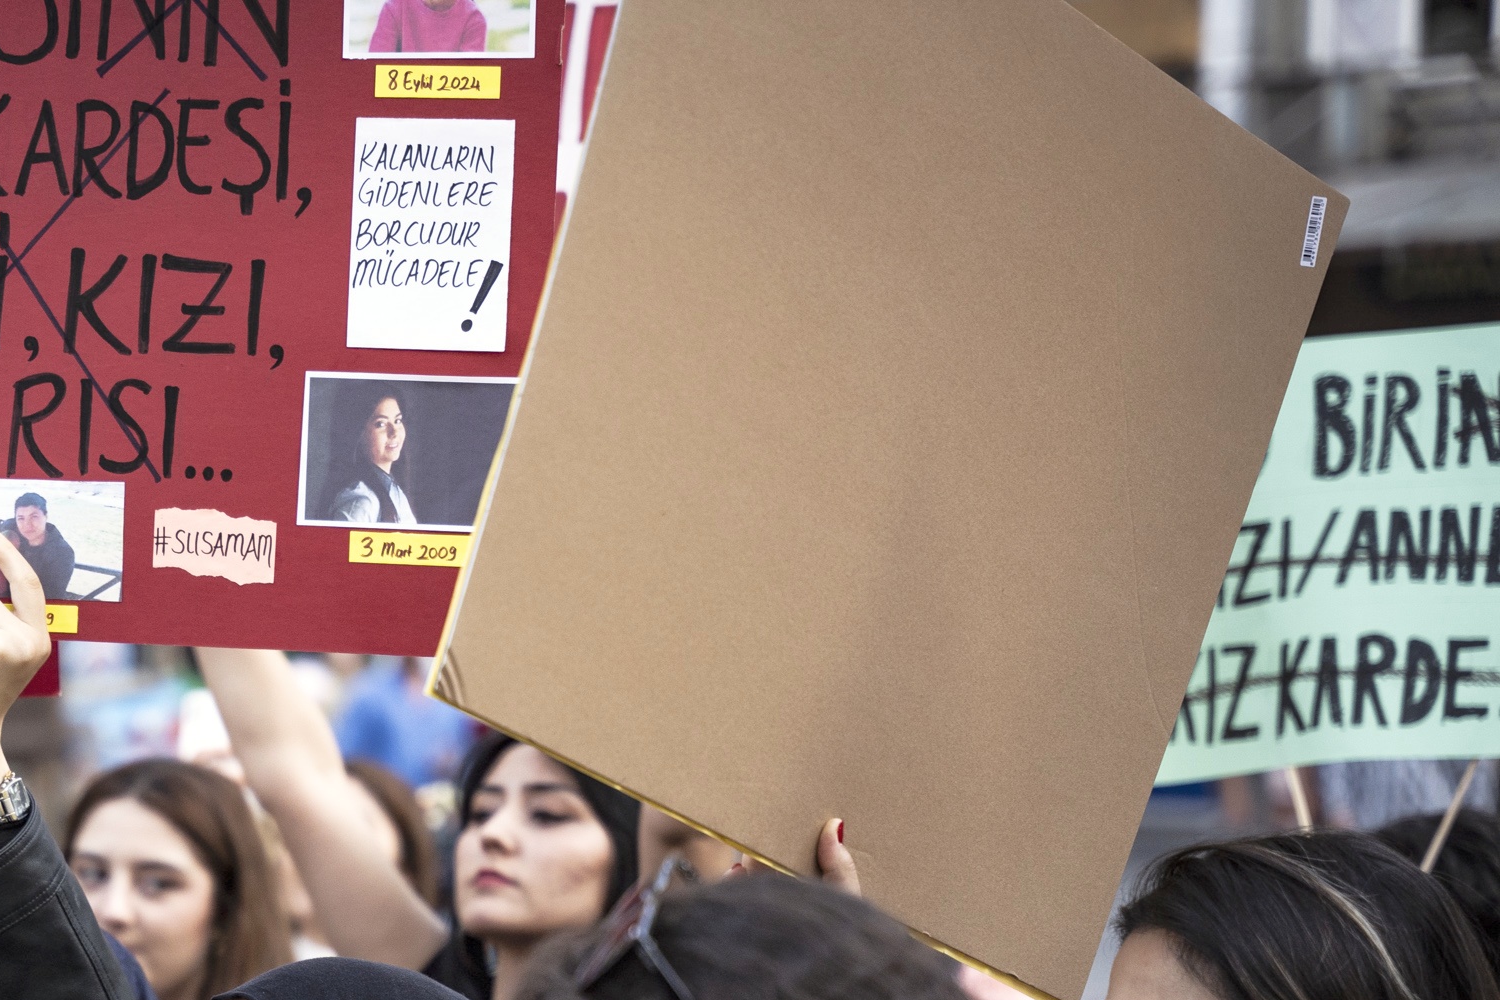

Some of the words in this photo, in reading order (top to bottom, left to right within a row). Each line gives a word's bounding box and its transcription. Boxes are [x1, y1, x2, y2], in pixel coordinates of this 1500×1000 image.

[387, 69, 399, 91] 8
[403, 71, 433, 92] Eylül
[437, 75, 481, 91] 2024
[359, 141, 495, 174] KALANLARIN
[358, 177, 498, 208] GİDENLERE
[355, 218, 481, 250] BORCUDUR
[63, 247, 285, 371] KIZI,
[154, 526, 273, 568] #SUSAMAM
[360, 536, 373, 558] 3
[381, 541, 412, 558] Mart
[416, 544, 457, 562] 2009
[1276, 633, 1500, 740] KARDE
